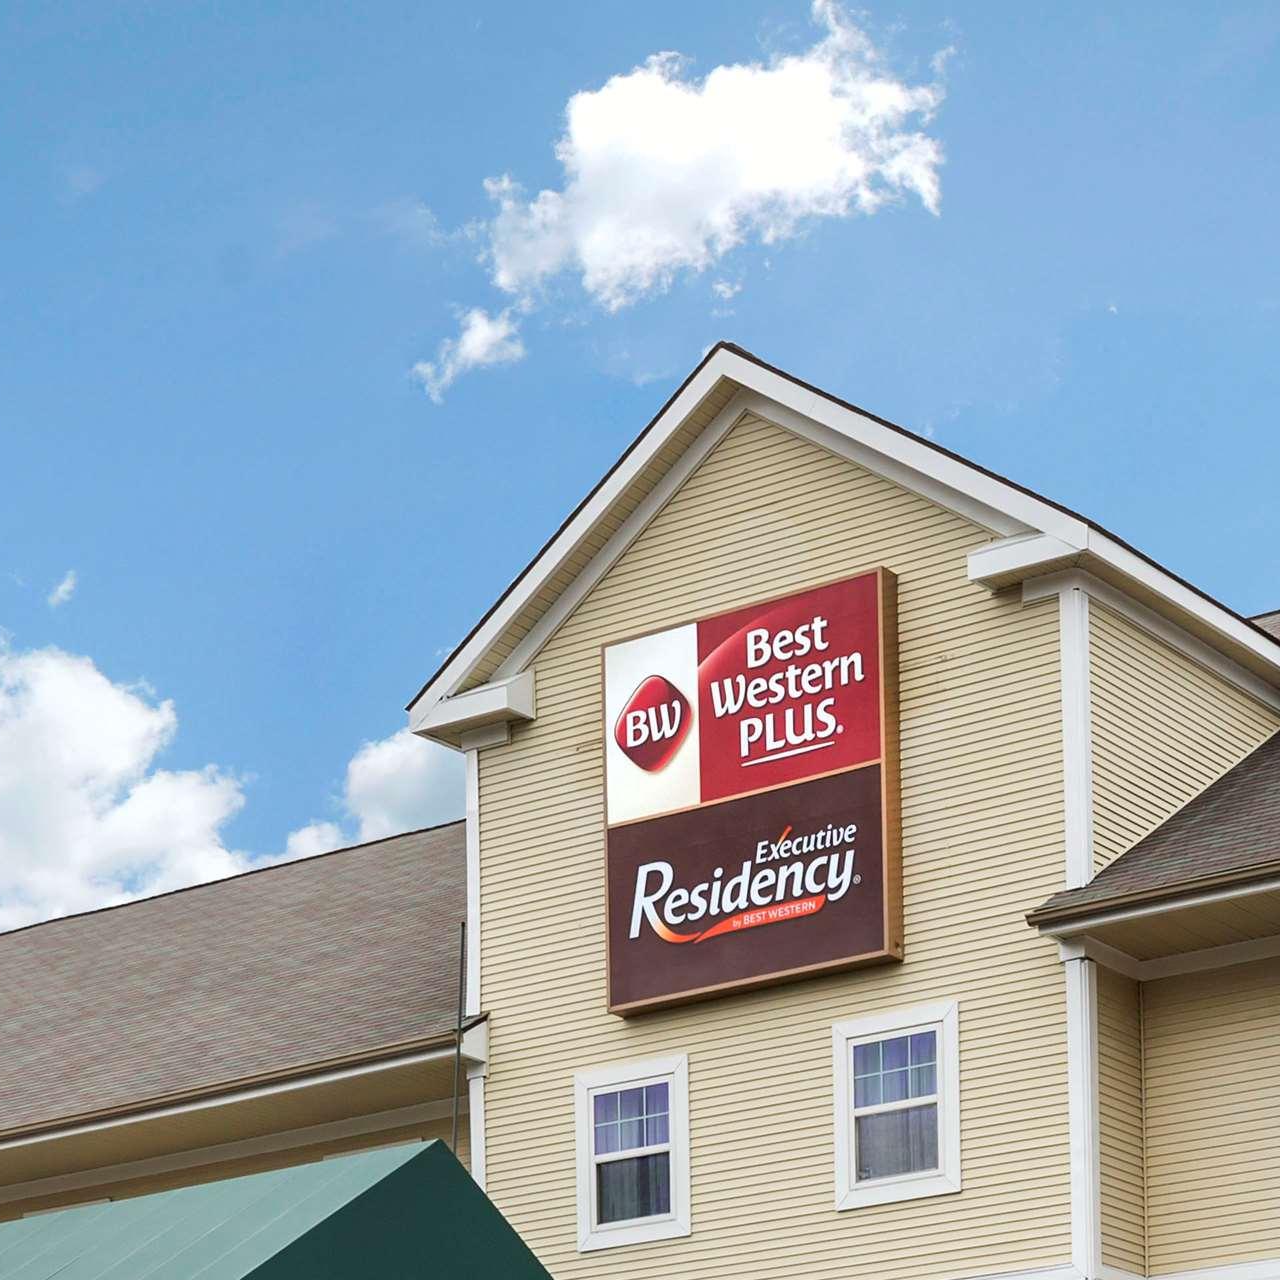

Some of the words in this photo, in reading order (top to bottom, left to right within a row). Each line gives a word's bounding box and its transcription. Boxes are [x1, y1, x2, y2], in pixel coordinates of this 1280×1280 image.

[746, 616, 829, 668] Best
[710, 652, 865, 718] Western
[626, 699, 682, 747] BW
[755, 824, 857, 864] Executive
[629, 848, 856, 942] Residency
[732, 918, 742, 928] by
[743, 911, 767, 925] BEST
[768, 900, 816, 920] WESTERN
